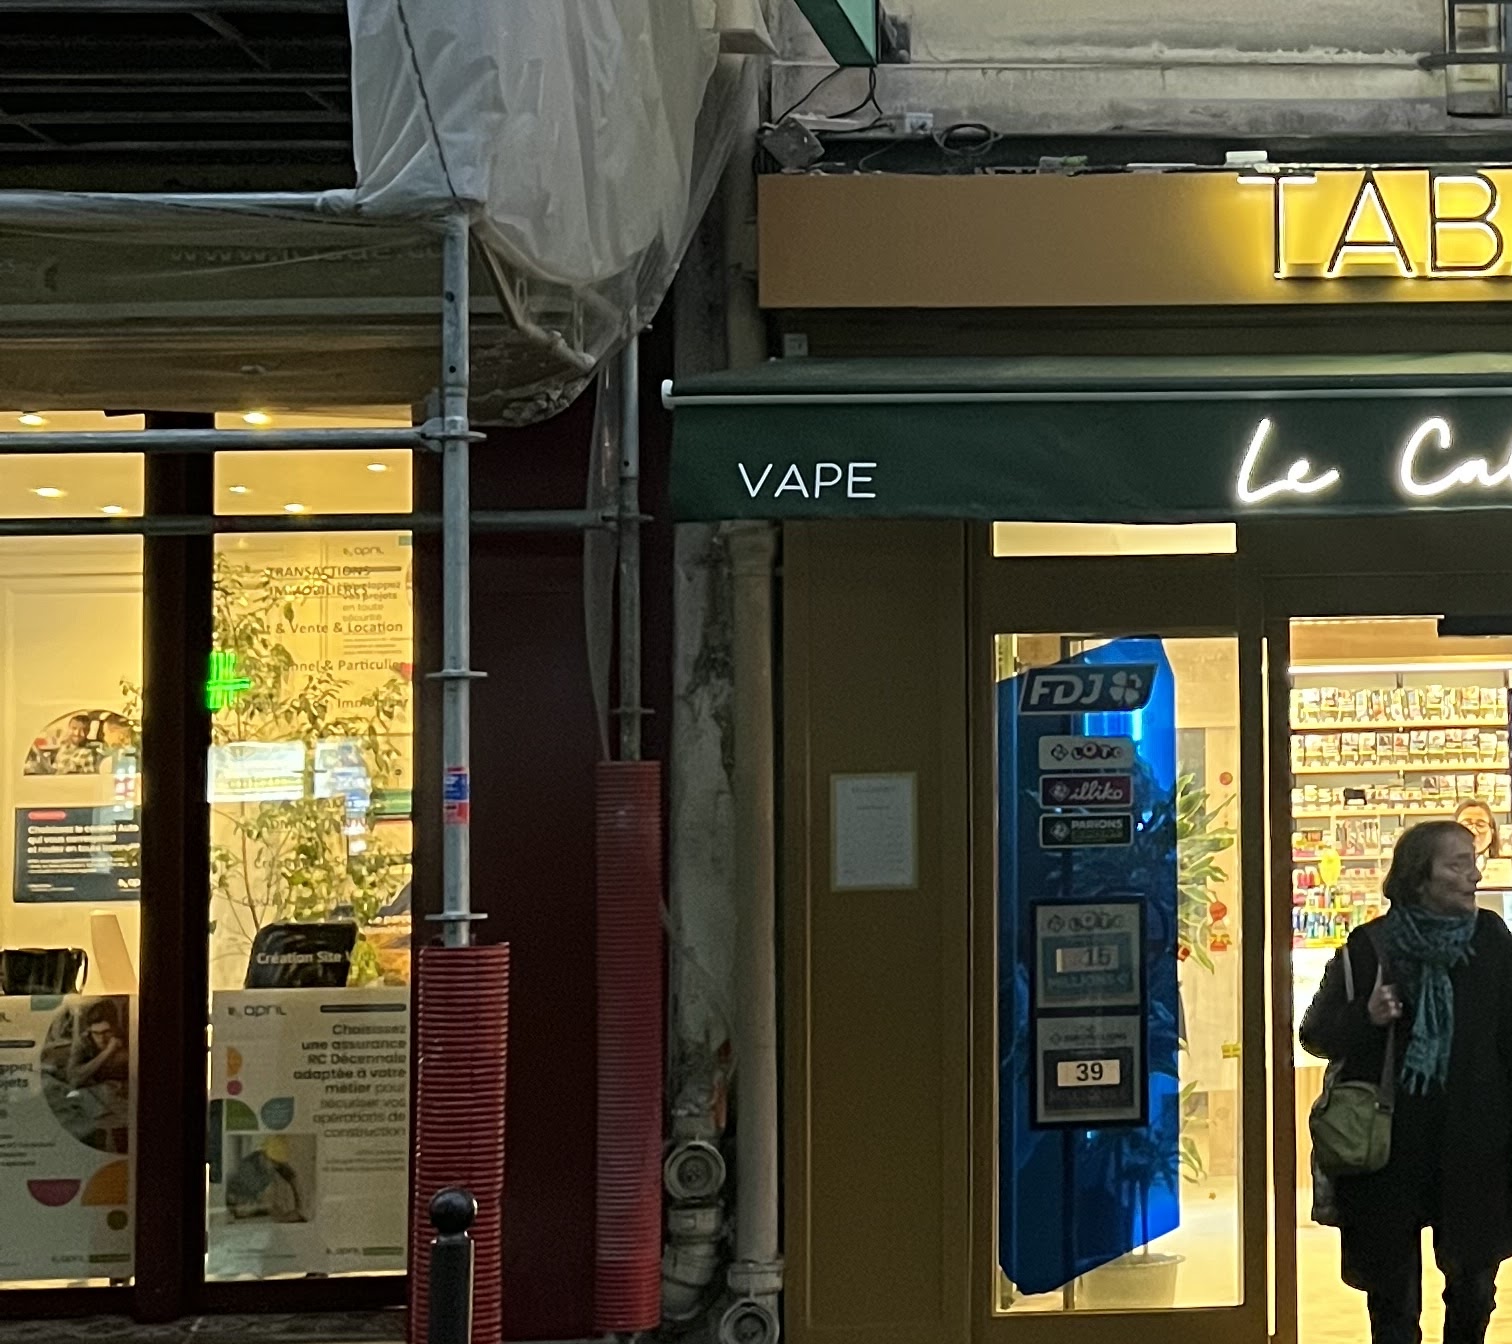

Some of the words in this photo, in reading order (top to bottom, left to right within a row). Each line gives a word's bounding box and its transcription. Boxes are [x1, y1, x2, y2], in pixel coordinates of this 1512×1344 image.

[1237, 417, 1340, 504] Le
[737, 462, 878, 499] VAPE
[291, 623, 329, 634] Vente
[333, 622, 343, 633] &
[347, 621, 404, 633] Location
[1029, 673, 1105, 705] FDJ
[1068, 780, 1124, 801] illiko
[1076, 1062, 1104, 1082] 39
